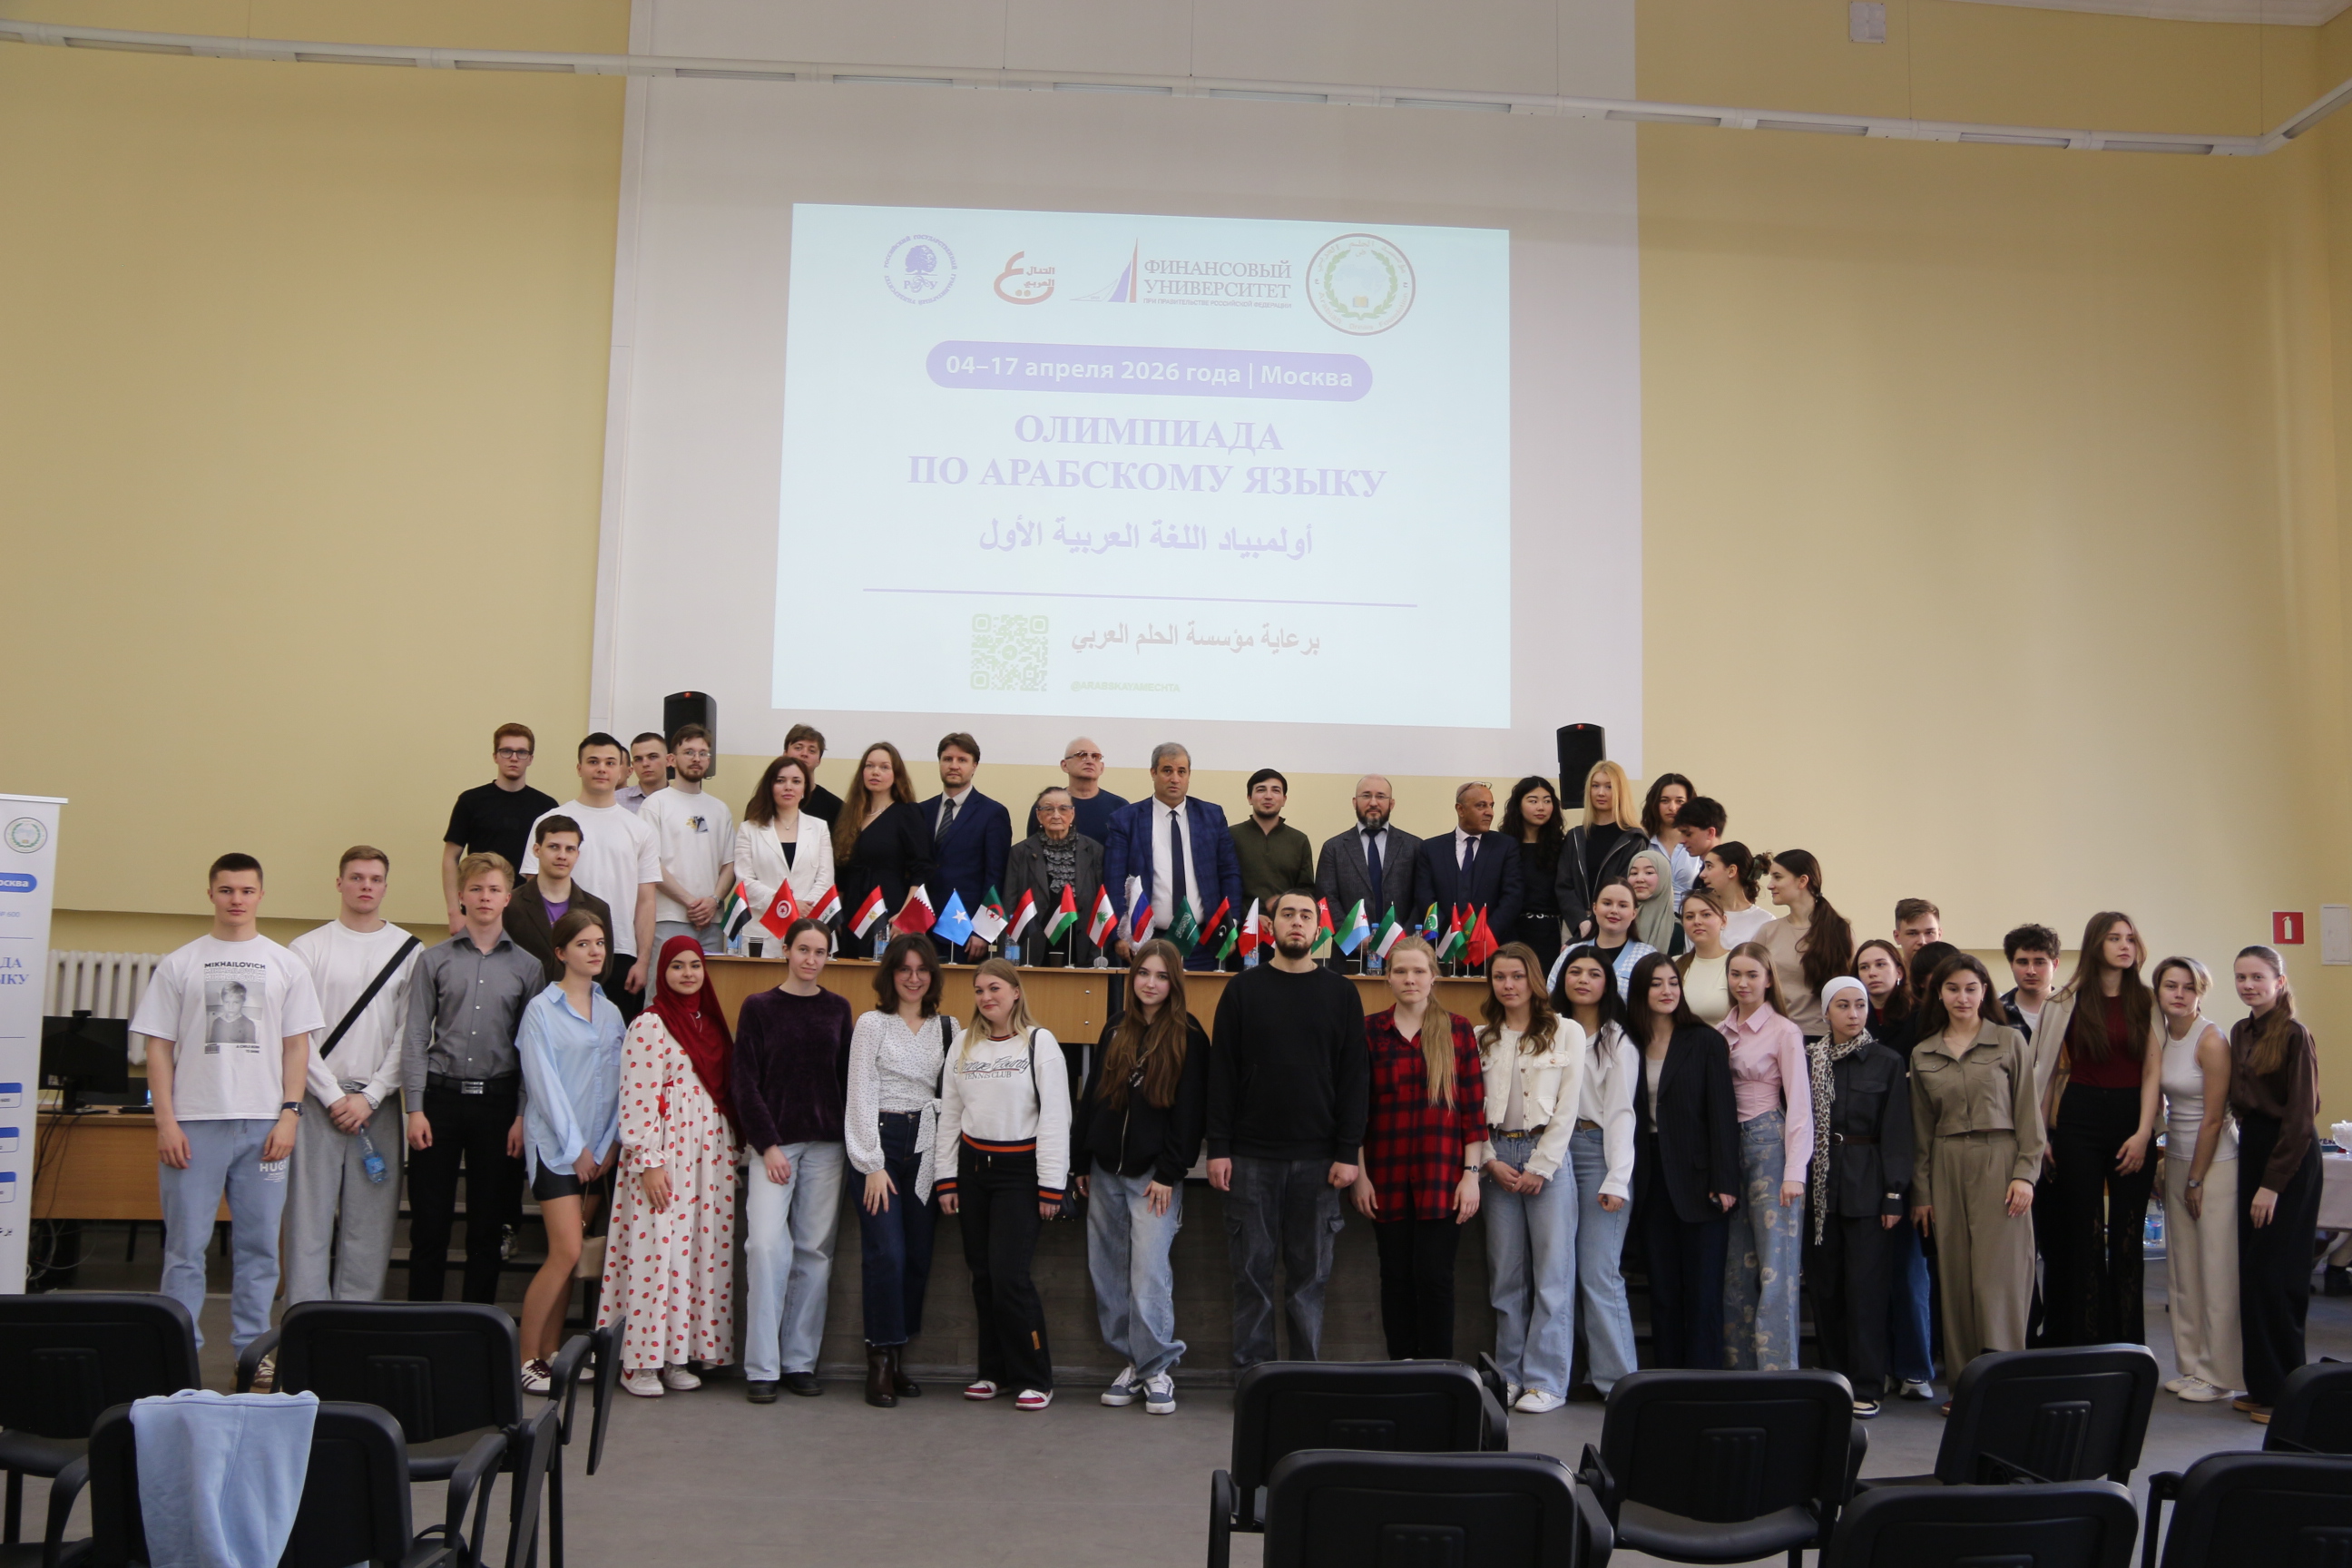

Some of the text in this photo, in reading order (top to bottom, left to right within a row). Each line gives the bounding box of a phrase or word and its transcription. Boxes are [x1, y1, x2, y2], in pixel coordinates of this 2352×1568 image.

[1143, 260, 1292, 279] ФИНАНСОВЫЙ
[1143, 279, 1291, 299] УНИВЕРСИТЕТ
[1157, 299, 1210, 307] ПРАВИТЕЛЬСТВЕ
[1210, 299, 1252, 308] РОССИЙСКОЙ
[1253, 301, 1292, 309] ФЕДЕРАЦИИ
[1024, 361, 1114, 382] апреля
[1121, 361, 1180, 381] 2026
[1186, 367, 1240, 386] года
[1260, 365, 1353, 387] Москва
[1014, 415, 1285, 456] ОЛИМПИАДА
[907, 456, 1387, 498] ПО АРАБСКОМУ ЯЗЫКУ
[979, 514, 1313, 561] أولمبياد اللغة العربية الأول
[1071, 622, 1129, 653] العربي
[1135, 622, 1179, 655] الحلم
[1185, 620, 1254, 654] مؤسسة
[1070, 681, 1181, 693] @ARABSKAYAMECHTA
[204, 961, 266, 970] MIKHAILOVICH
[965, 1071, 1012, 1081] TENNIS CLUB
